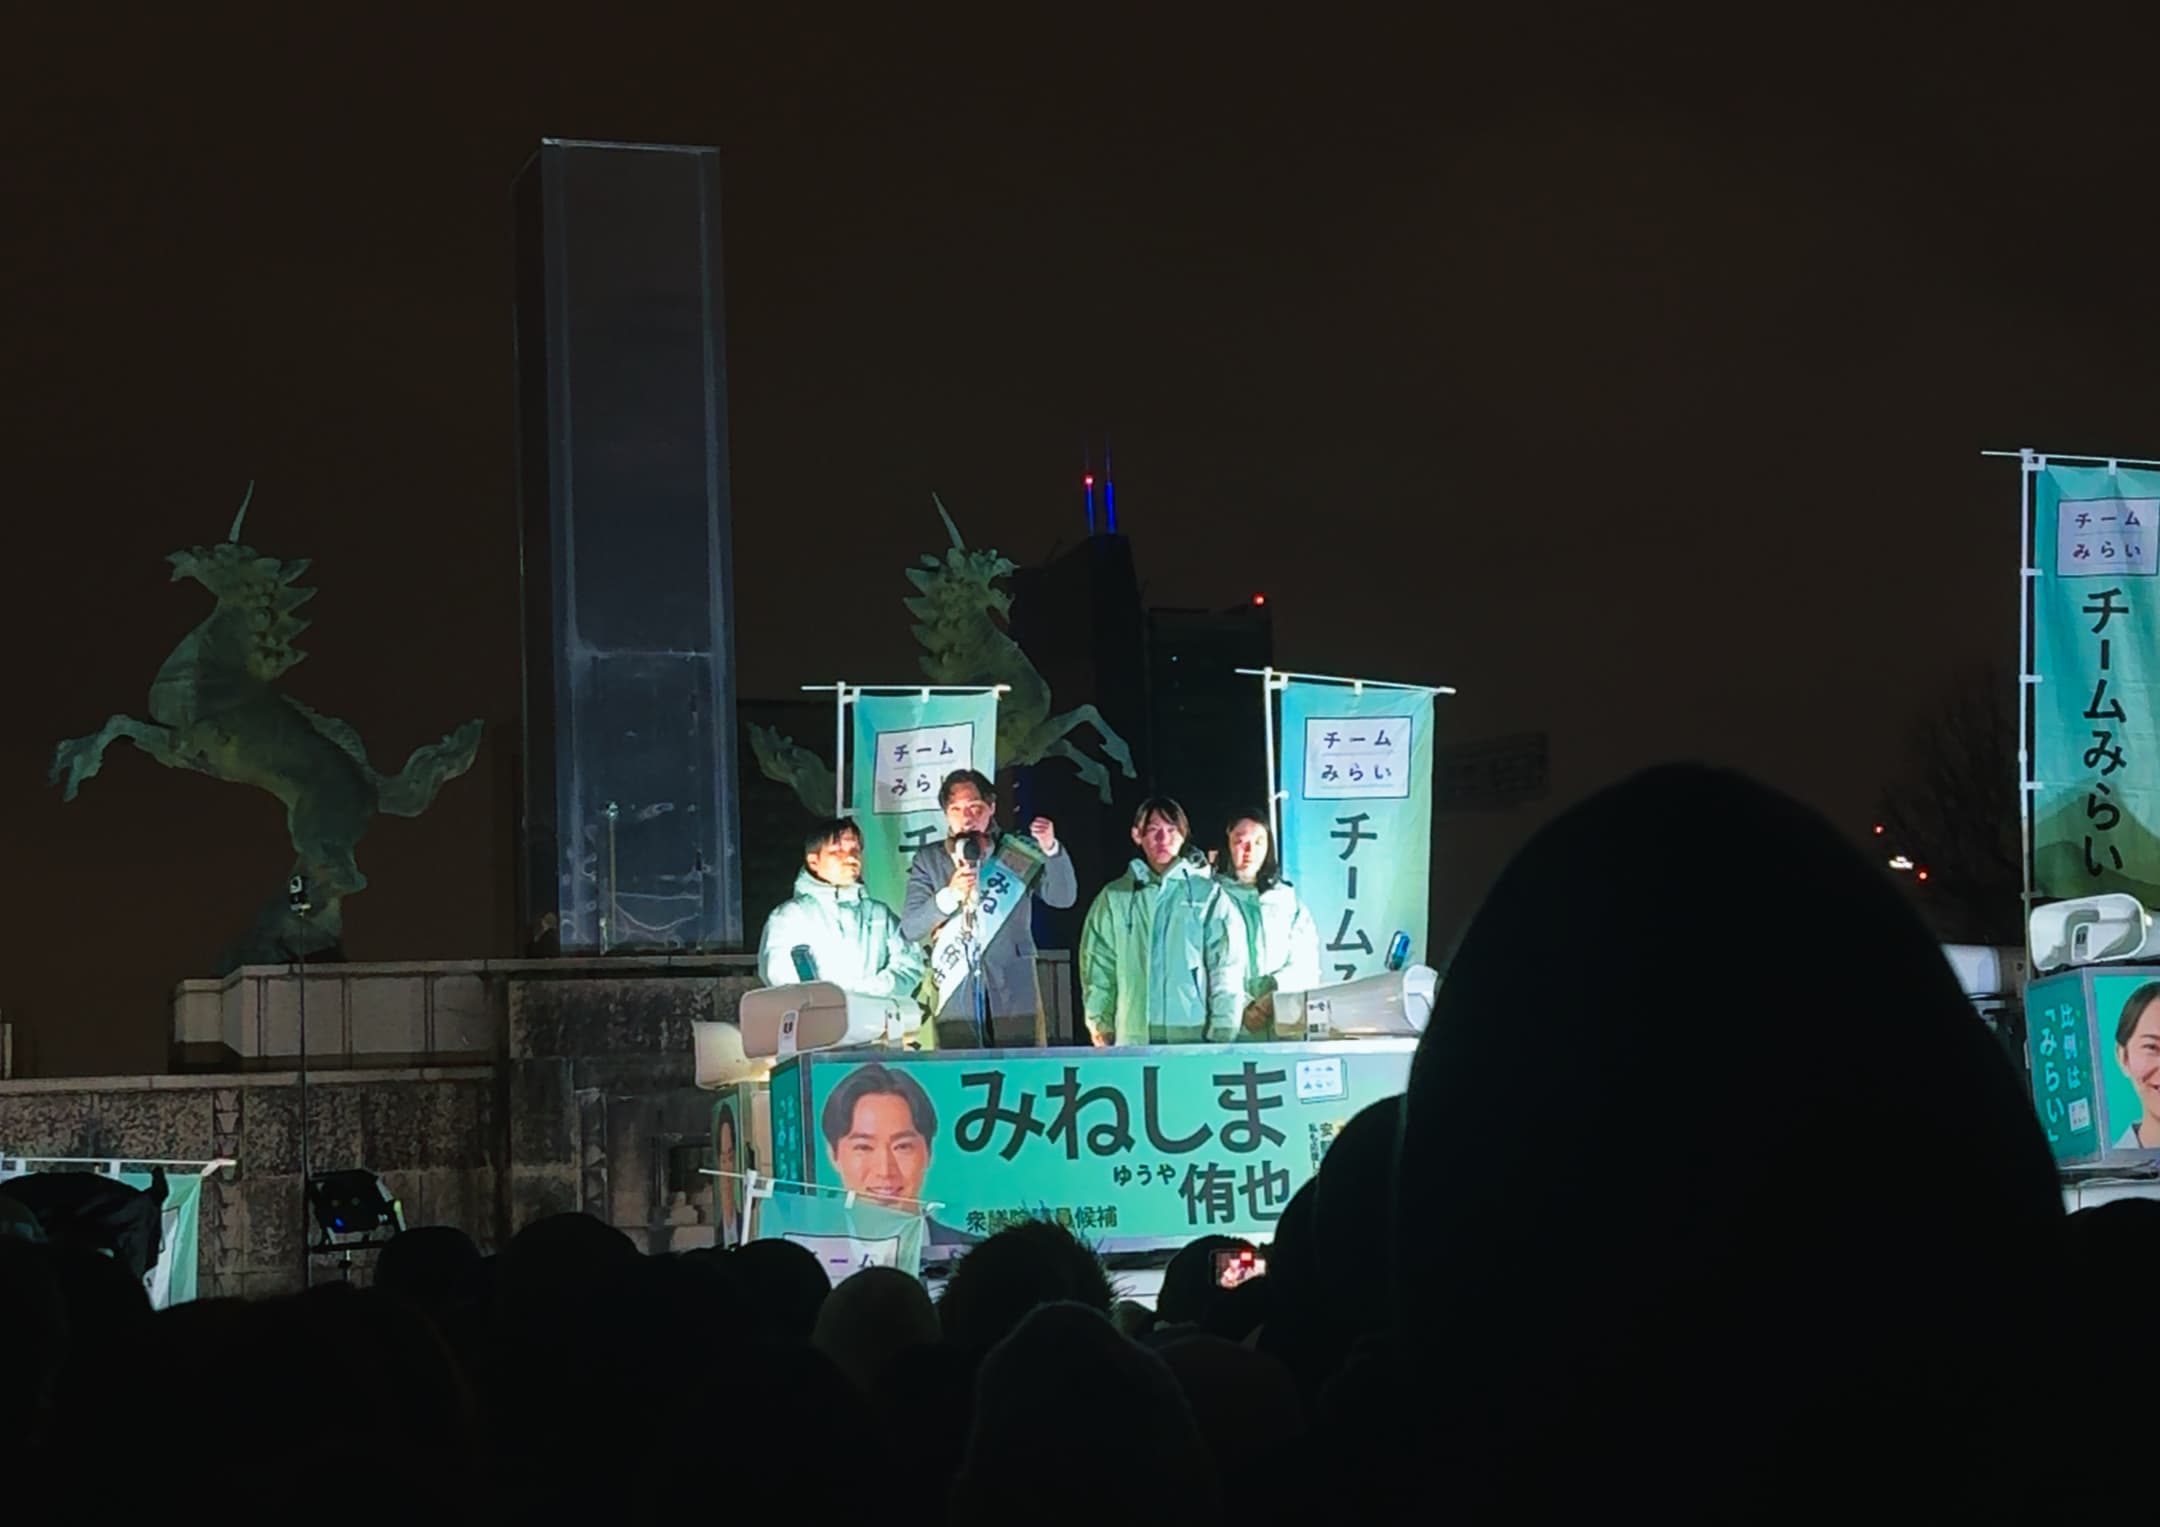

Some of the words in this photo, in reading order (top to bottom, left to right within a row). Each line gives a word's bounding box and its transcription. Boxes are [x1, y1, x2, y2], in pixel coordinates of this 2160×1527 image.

[2075, 511, 2141, 528] チーム
[2072, 541, 2142, 560] みらい
[1323, 730, 1391, 749] チーム
[2081, 587, 2129, 878] チームみらい
[893, 738, 954, 762] チーム
[1321, 762, 1391, 781] みらい
[891, 773, 945, 796] みら
[954, 1061, 1287, 1161] みねしま
[1113, 1164, 1177, 1187] ゆうや
